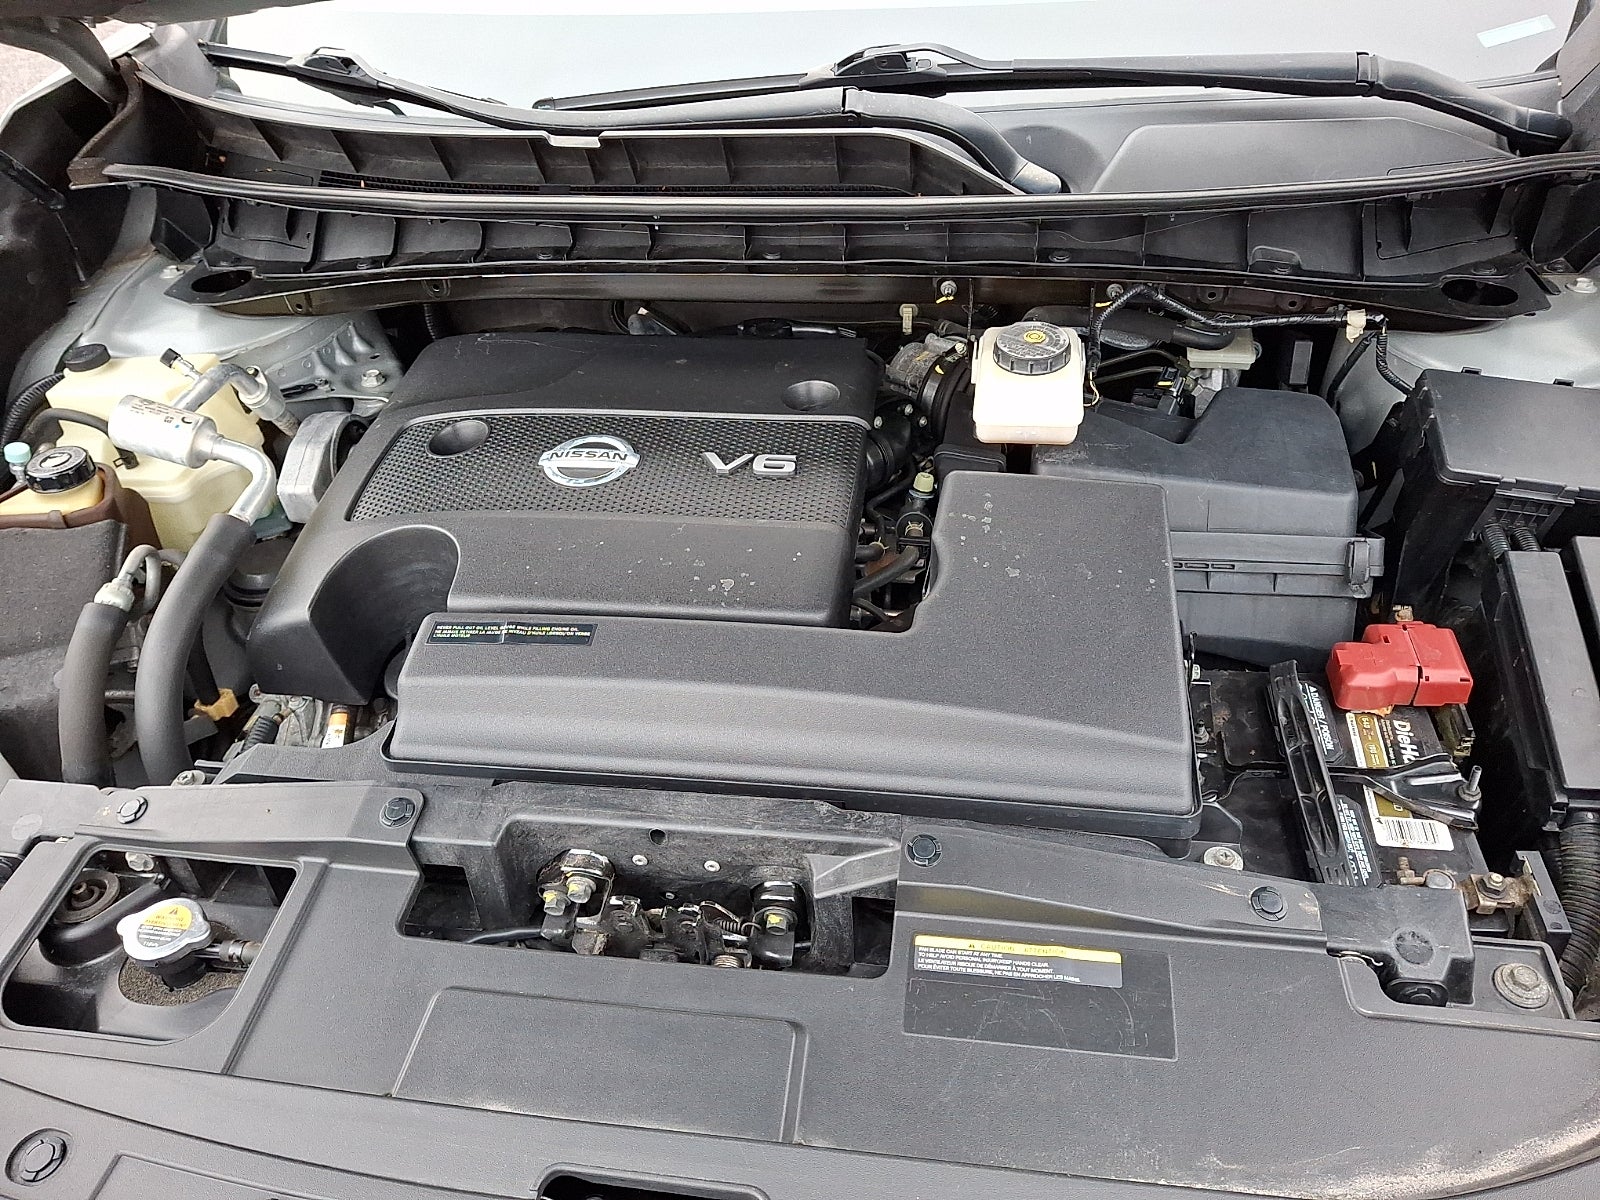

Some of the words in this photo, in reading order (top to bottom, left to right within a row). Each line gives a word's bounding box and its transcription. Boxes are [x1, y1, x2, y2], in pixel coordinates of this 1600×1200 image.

[549, 450, 628, 462] NISSAN
[703, 452, 798, 476] V6
[1310, 691, 1326, 720] DANGER
[1320, 724, 1334, 750] POISON
[980, 944, 1015, 952] CAUTION
